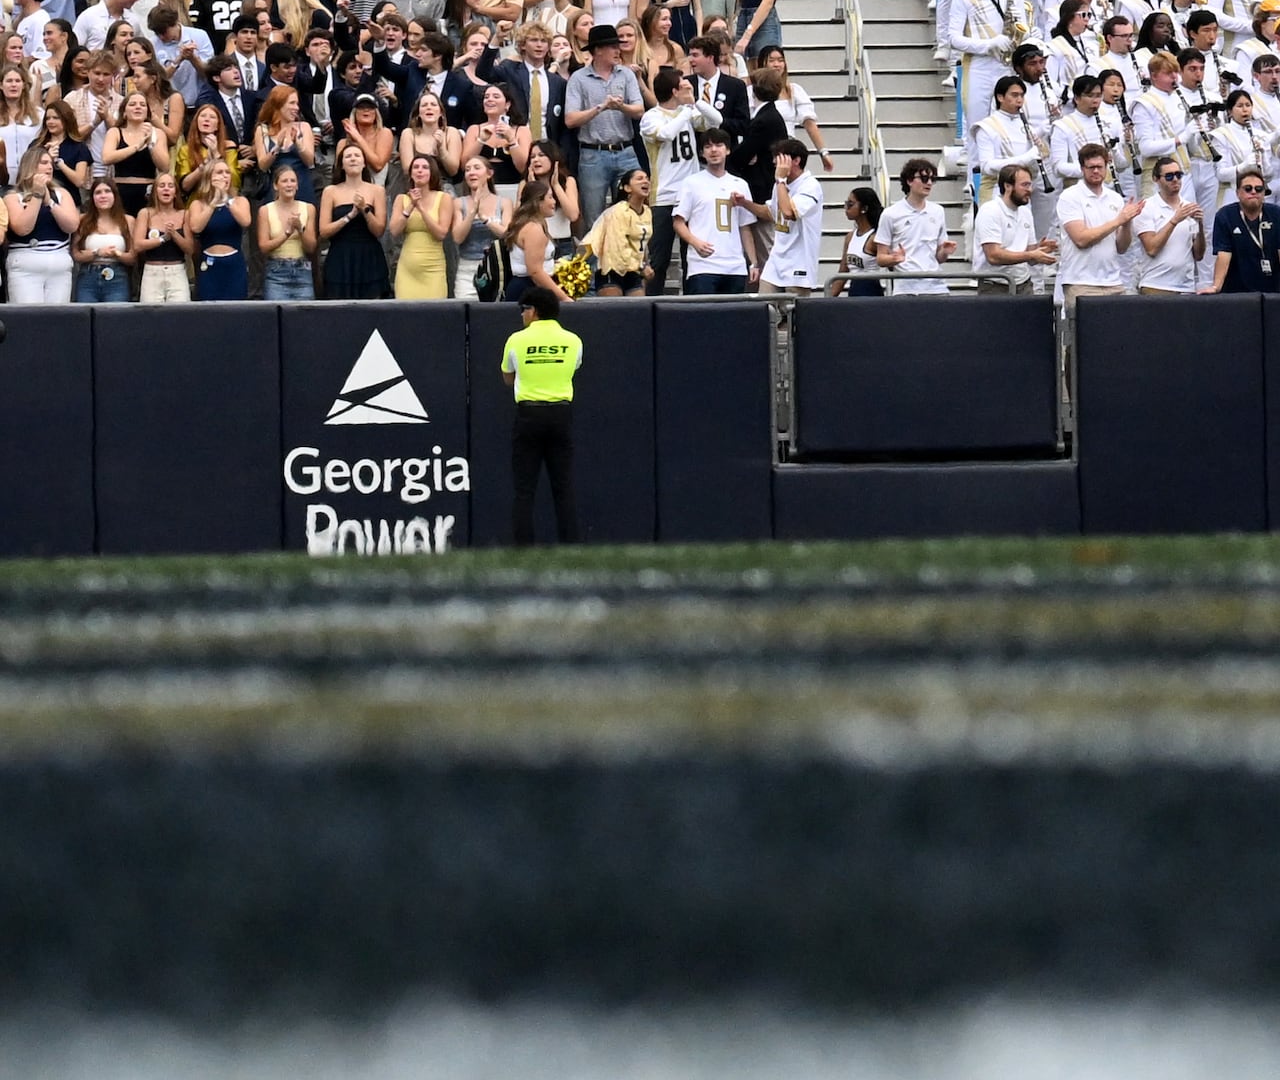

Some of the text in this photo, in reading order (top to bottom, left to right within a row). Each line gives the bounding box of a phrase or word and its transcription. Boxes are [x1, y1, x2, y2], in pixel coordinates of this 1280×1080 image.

[212, 1, 241, 30] 22
[670, 132, 694, 163] 18
[526, 345, 569, 355] BEST
[283, 445, 470, 503] Georgia
[305, 504, 455, 556] Power
